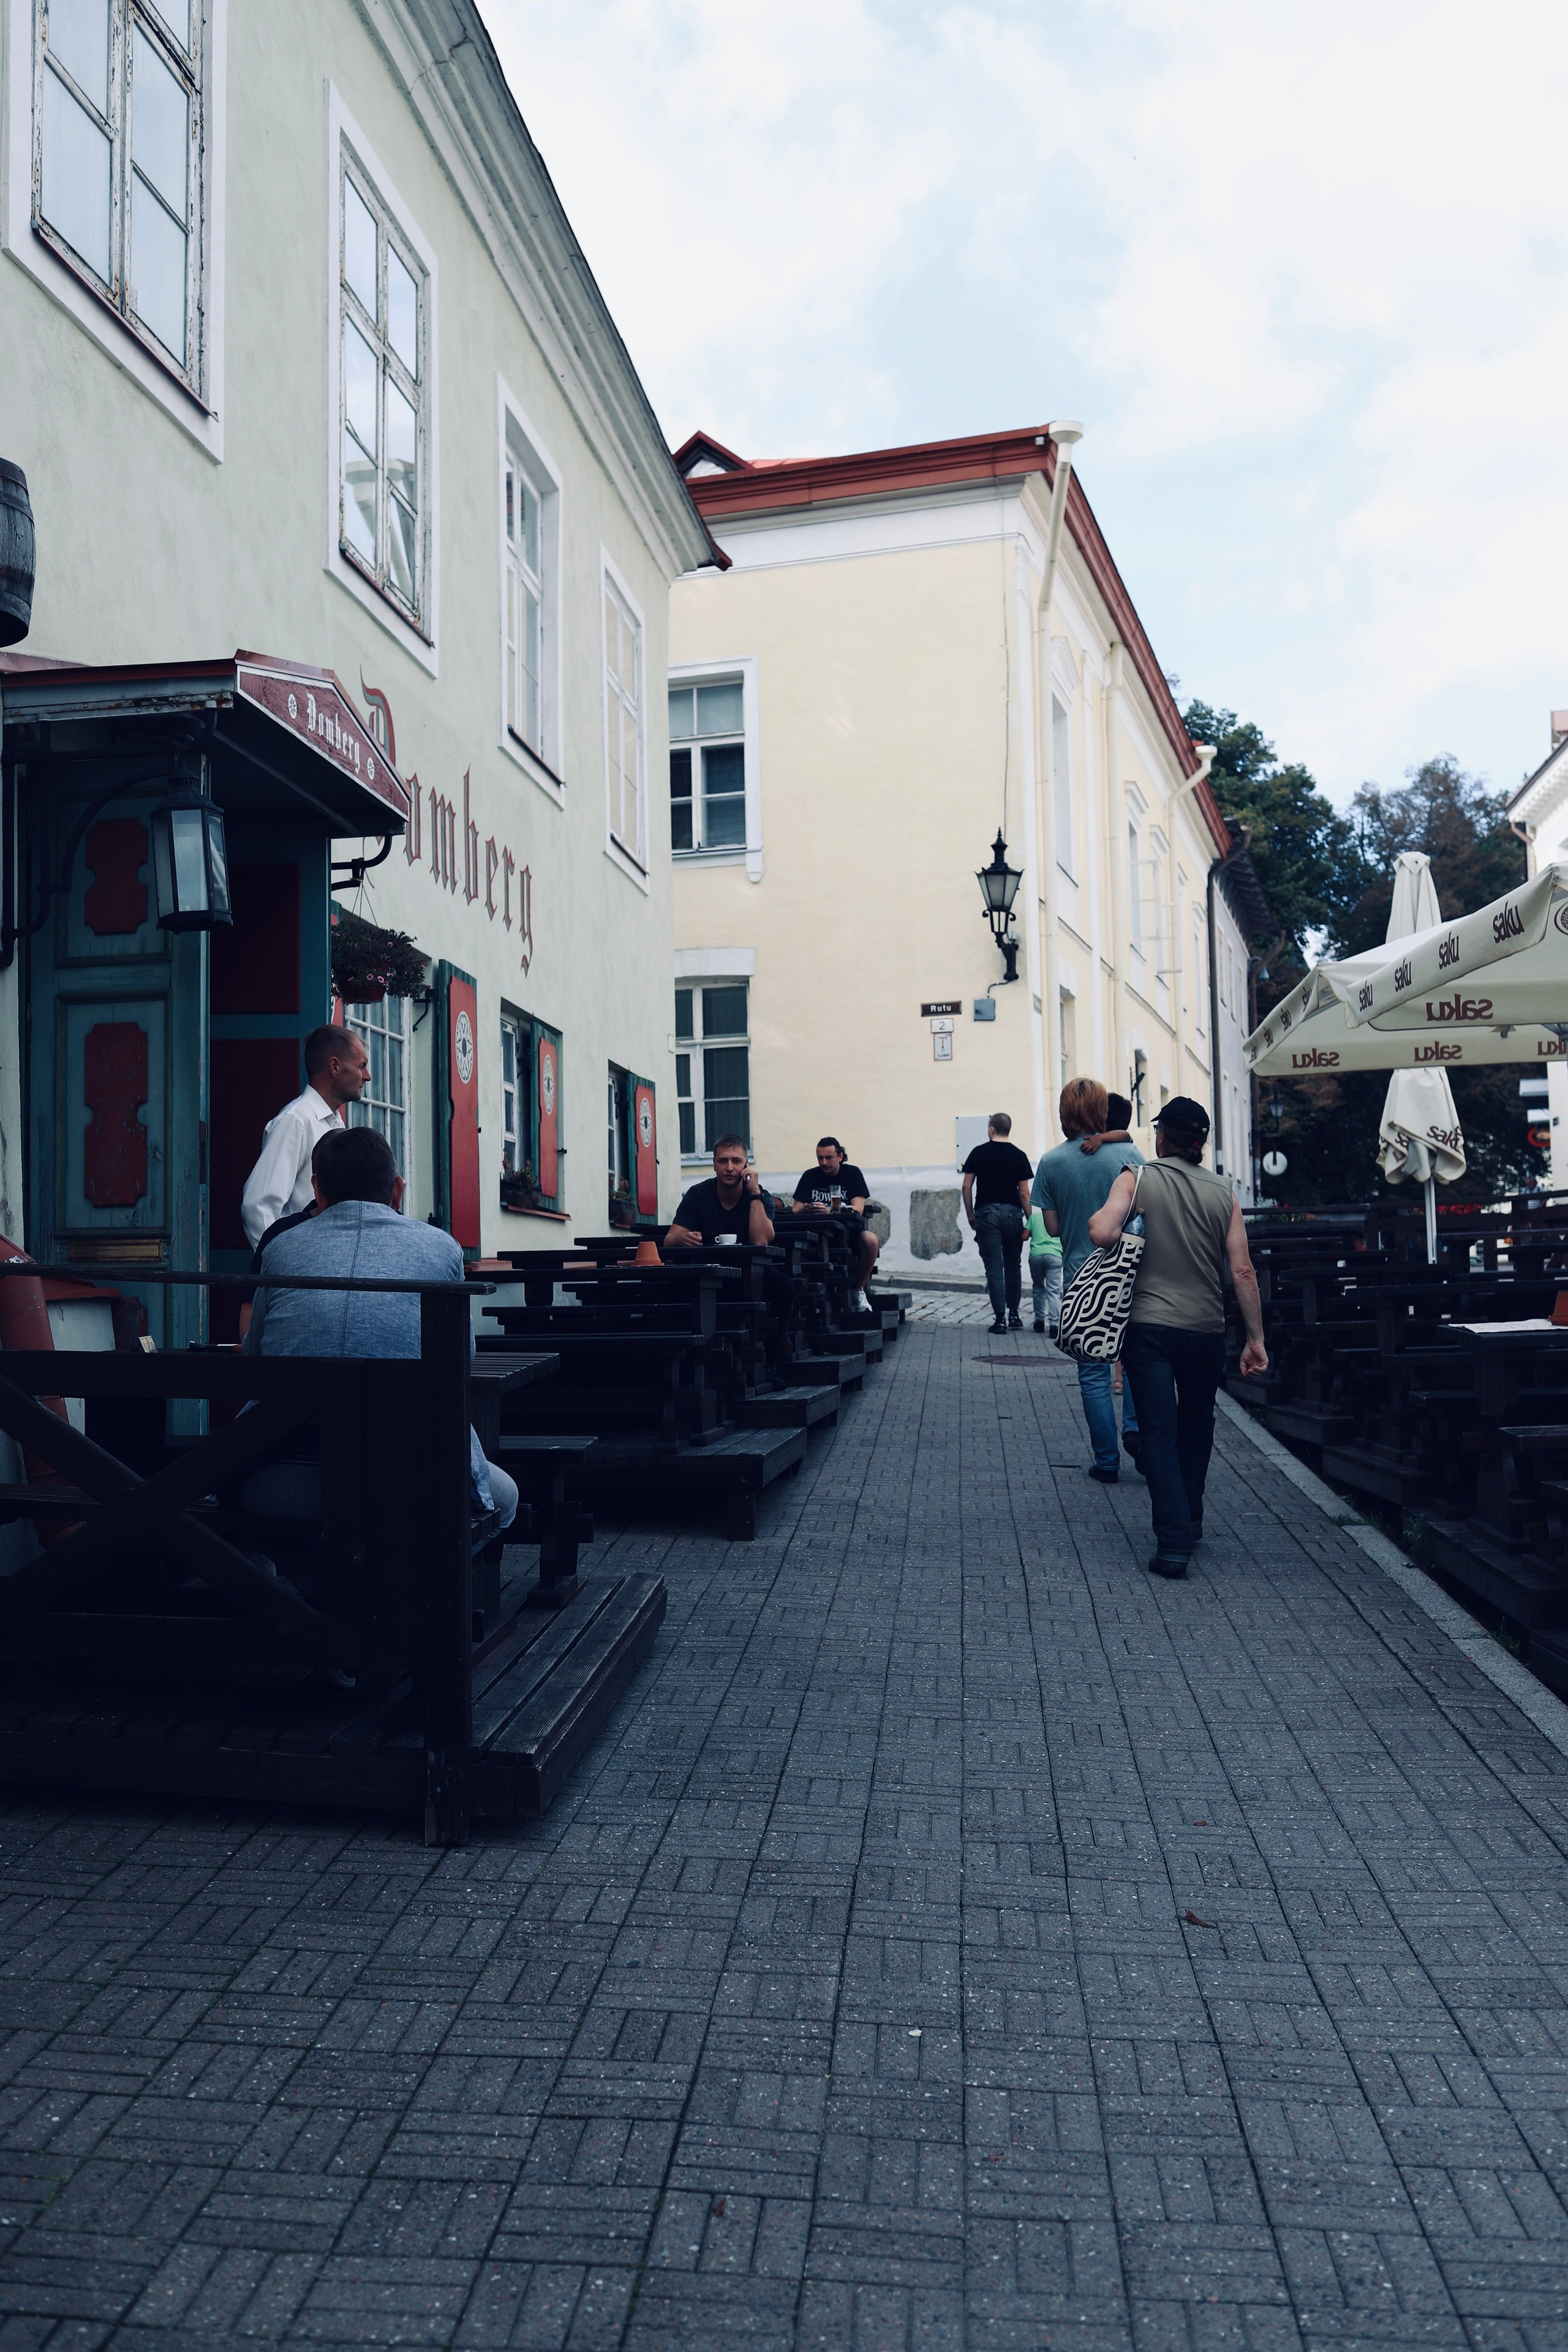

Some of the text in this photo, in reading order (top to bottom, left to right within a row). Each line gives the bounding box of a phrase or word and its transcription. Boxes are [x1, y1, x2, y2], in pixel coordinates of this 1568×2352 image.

[306, 690, 361, 775] Domberg
[1493, 900, 1525, 943] saku
[1439, 930, 1460, 970] saku
[1395, 957, 1412, 992] saku
[1359, 980, 1373, 1012] saku
[939, 1021, 945, 1030] 2
